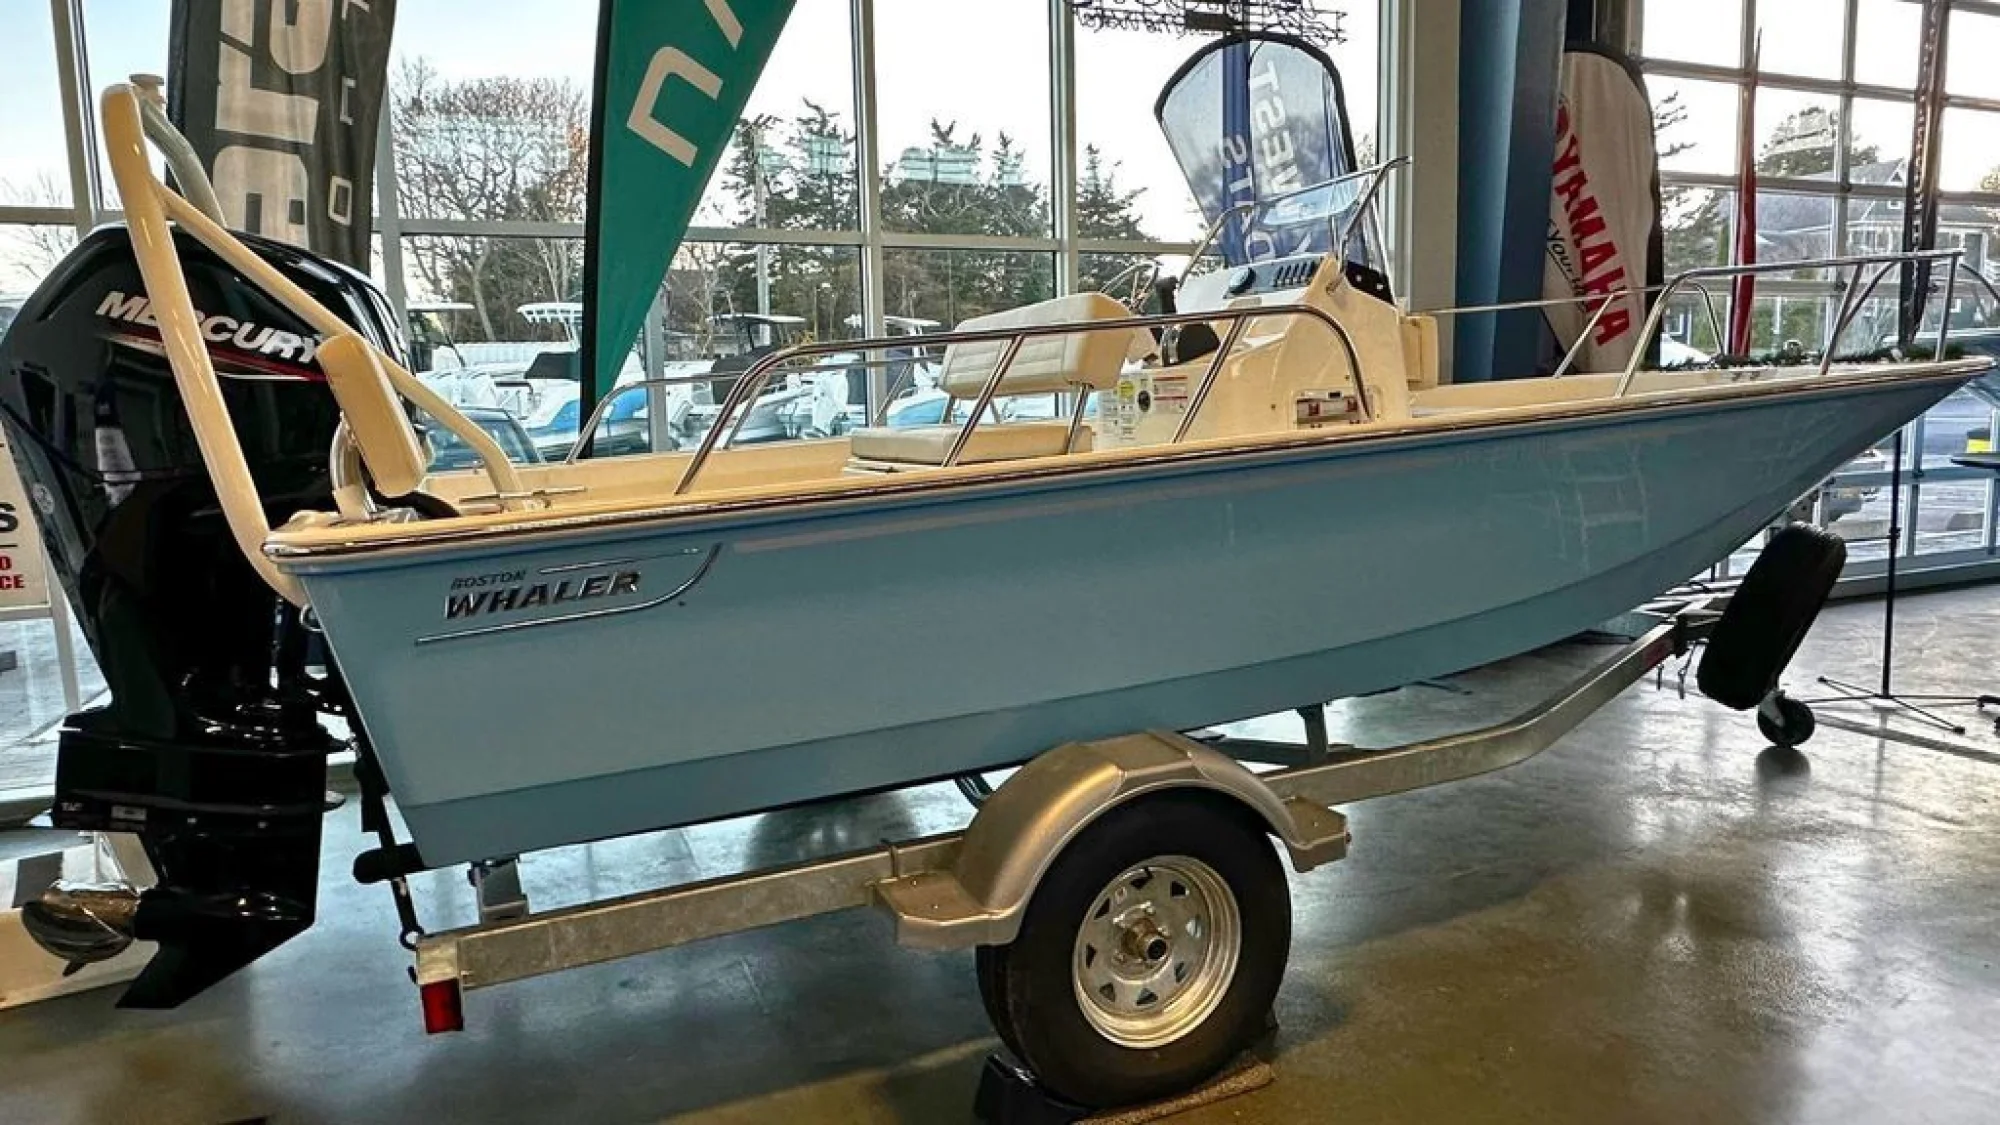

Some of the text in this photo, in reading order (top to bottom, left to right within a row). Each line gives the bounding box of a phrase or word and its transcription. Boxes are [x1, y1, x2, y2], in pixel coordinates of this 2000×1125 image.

[1552, 134, 1630, 346] YAMAHA
[95, 290, 322, 363] MCURY
[444, 570, 641, 619] WHALER
[451, 569, 527, 589] BOSTON
